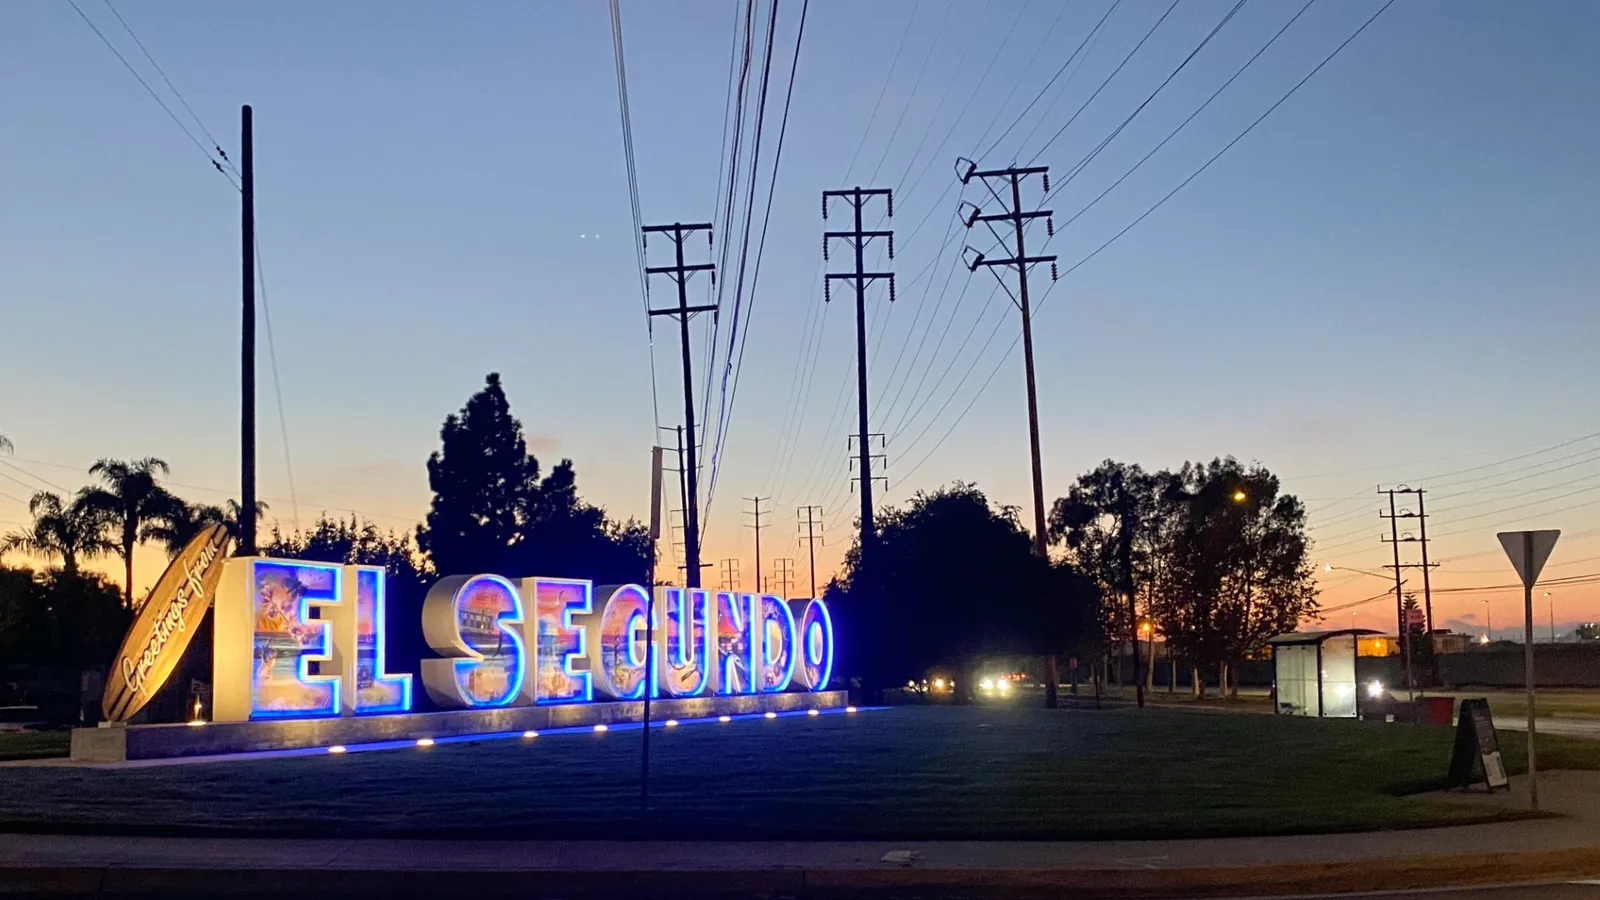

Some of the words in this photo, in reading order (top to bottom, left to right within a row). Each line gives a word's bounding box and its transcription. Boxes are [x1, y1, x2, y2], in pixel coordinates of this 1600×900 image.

[121, 588, 189, 697] Greetings
[183, 538, 219, 598] from
[248, 557, 413, 720] EL
[422, 573, 834, 708] SEGUNDO
